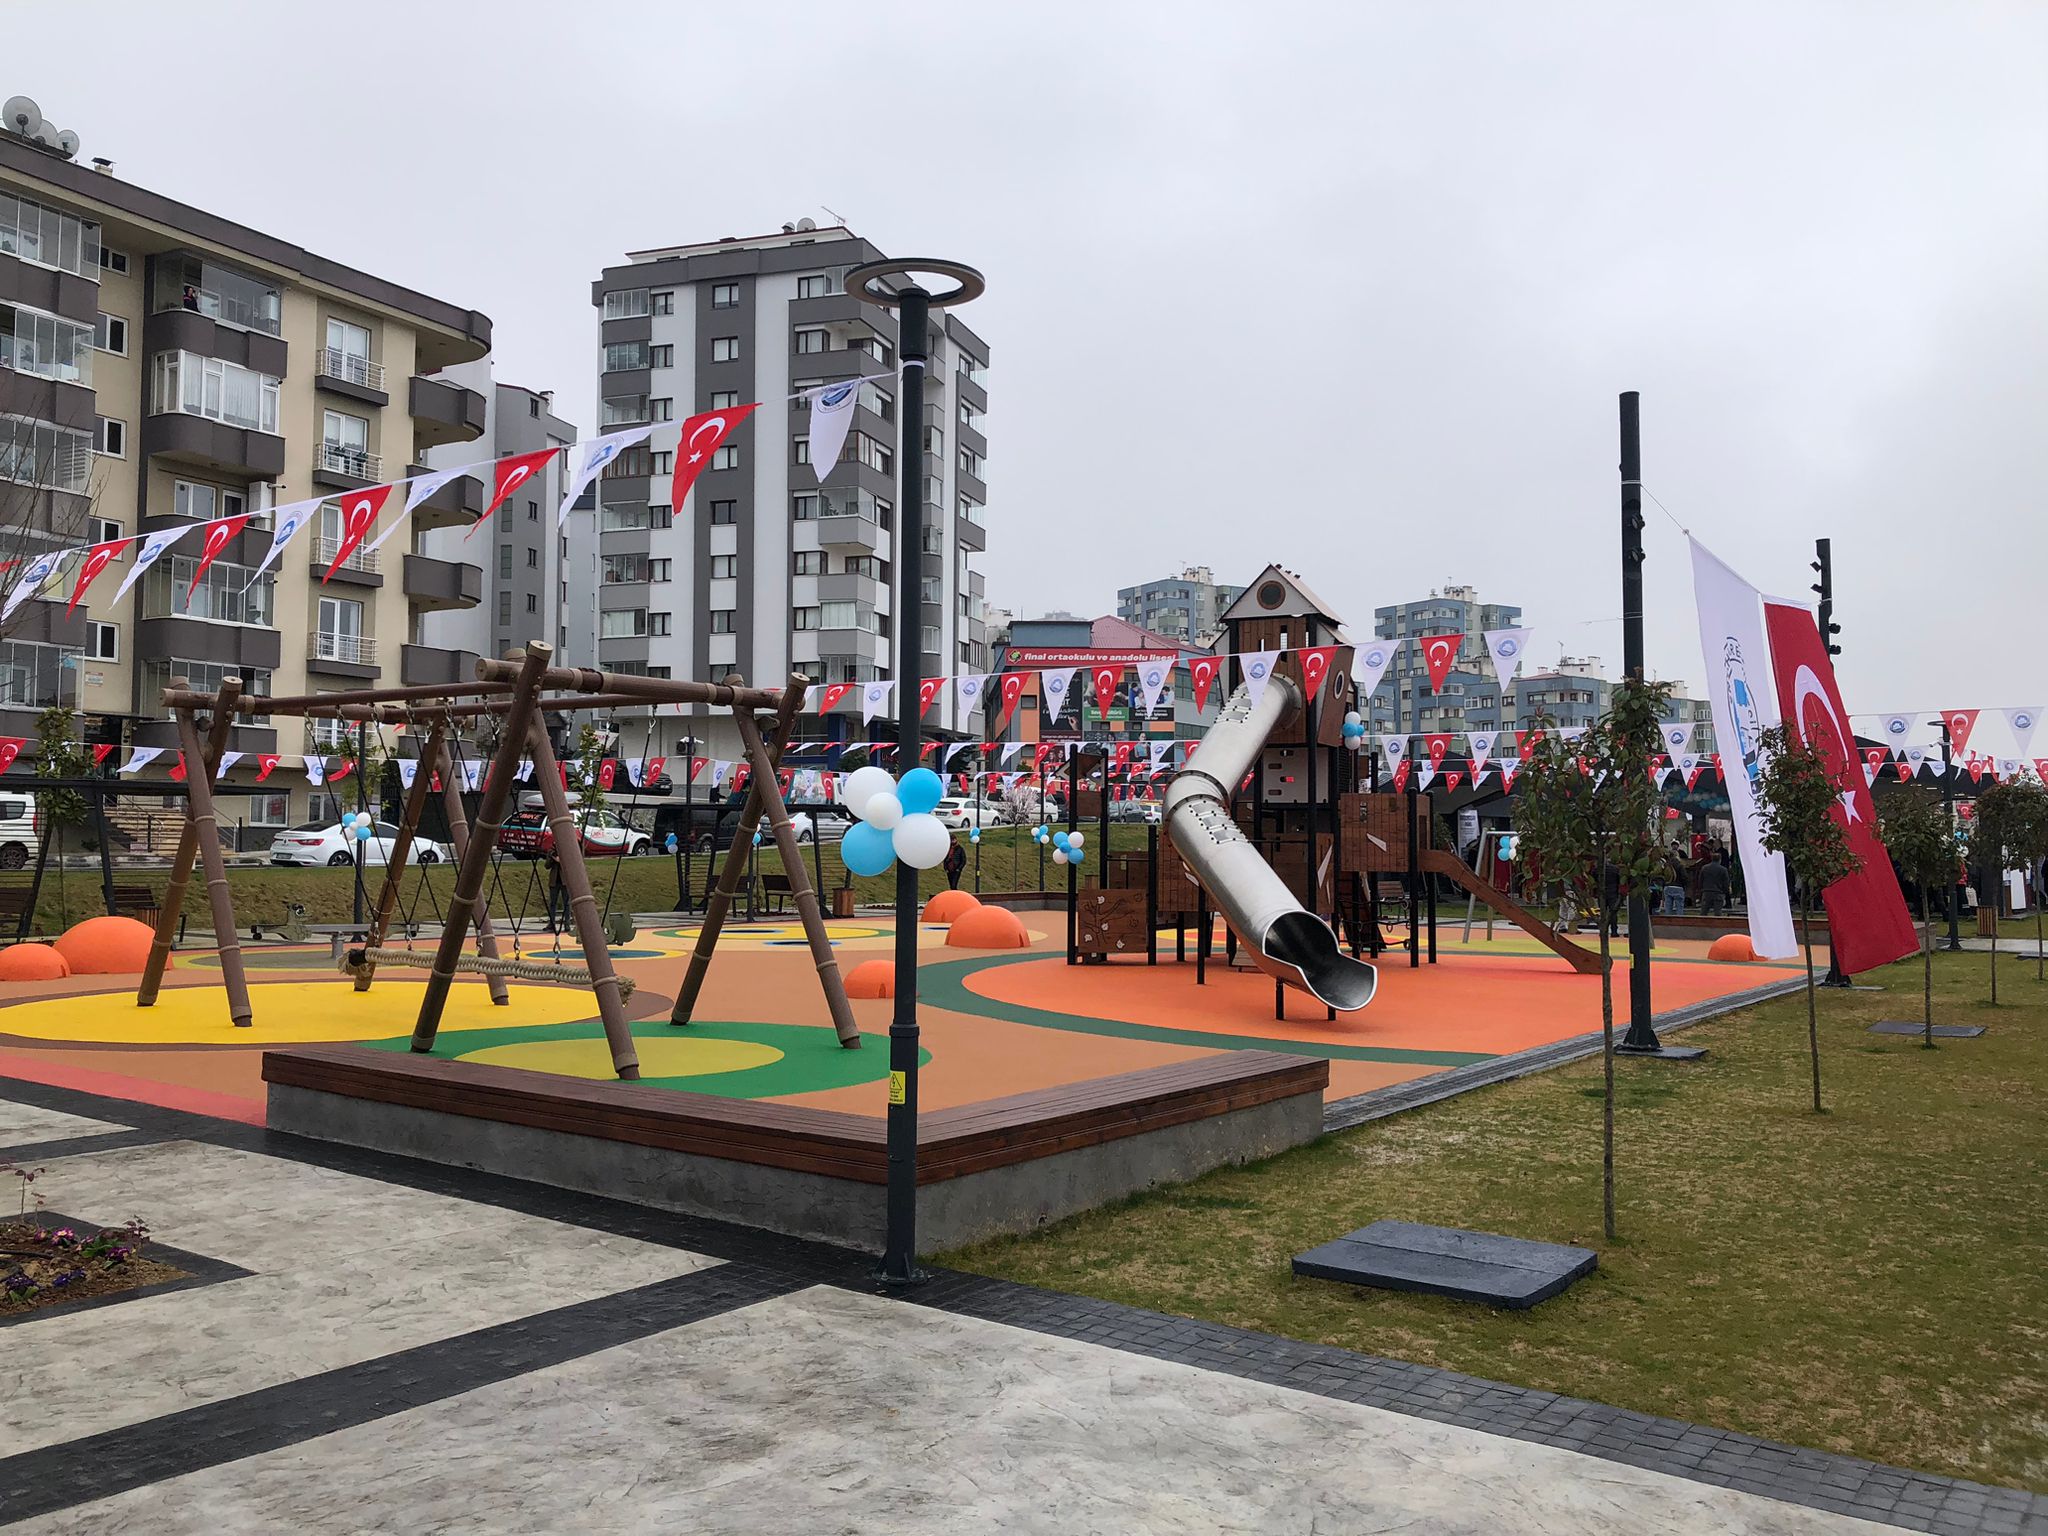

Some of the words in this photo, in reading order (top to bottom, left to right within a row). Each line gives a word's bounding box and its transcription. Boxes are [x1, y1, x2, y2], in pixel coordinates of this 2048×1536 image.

[1024, 653, 1046, 661] final
[1048, 653, 1095, 661] ortaokulu
[1109, 653, 1148, 661] anadolu
